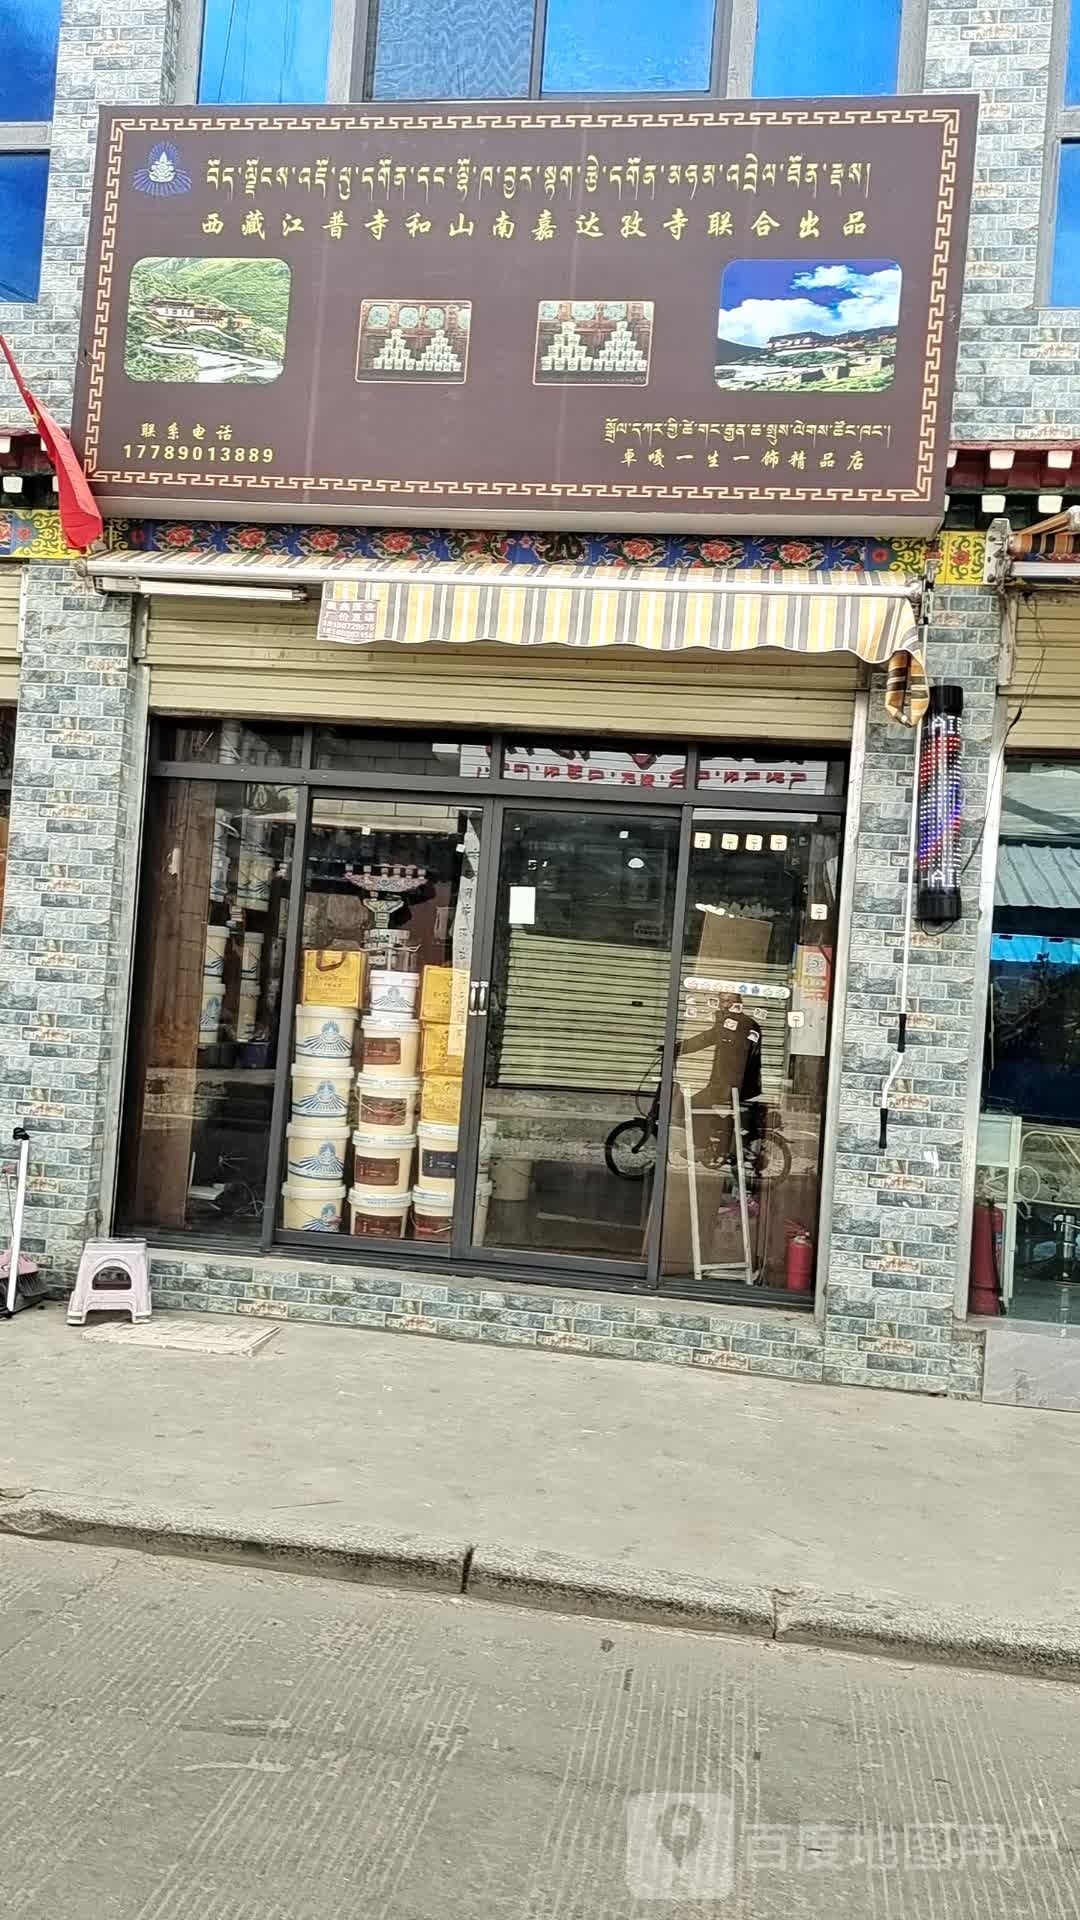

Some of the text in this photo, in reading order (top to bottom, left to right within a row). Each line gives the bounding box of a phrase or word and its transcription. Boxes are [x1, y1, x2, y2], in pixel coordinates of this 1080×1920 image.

[201, 208, 868, 242] 西藏江普寺和山南嘉达孜寺联合出品
[140, 422, 234, 441] 联系电话
[123, 444, 274, 464] 17789013889
[620, 447, 865, 472] 卓嘎一生一饰精品店
